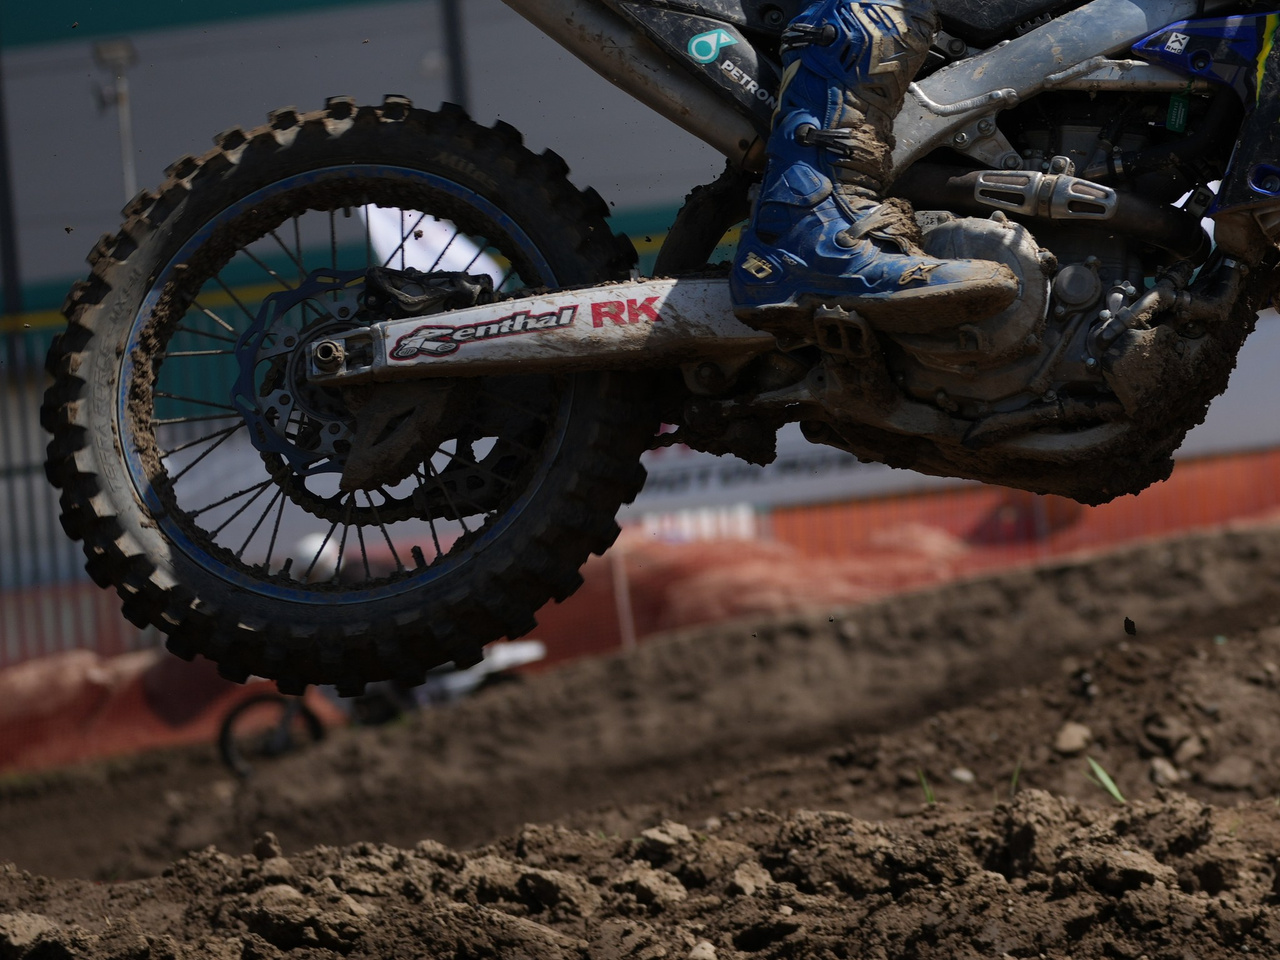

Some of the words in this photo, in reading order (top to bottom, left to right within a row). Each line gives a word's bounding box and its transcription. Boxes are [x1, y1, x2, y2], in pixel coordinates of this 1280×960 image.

[1166, 44, 1183, 55] RMG
[389, 305, 579, 360] Renthal
[590, 296, 662, 329] RK
